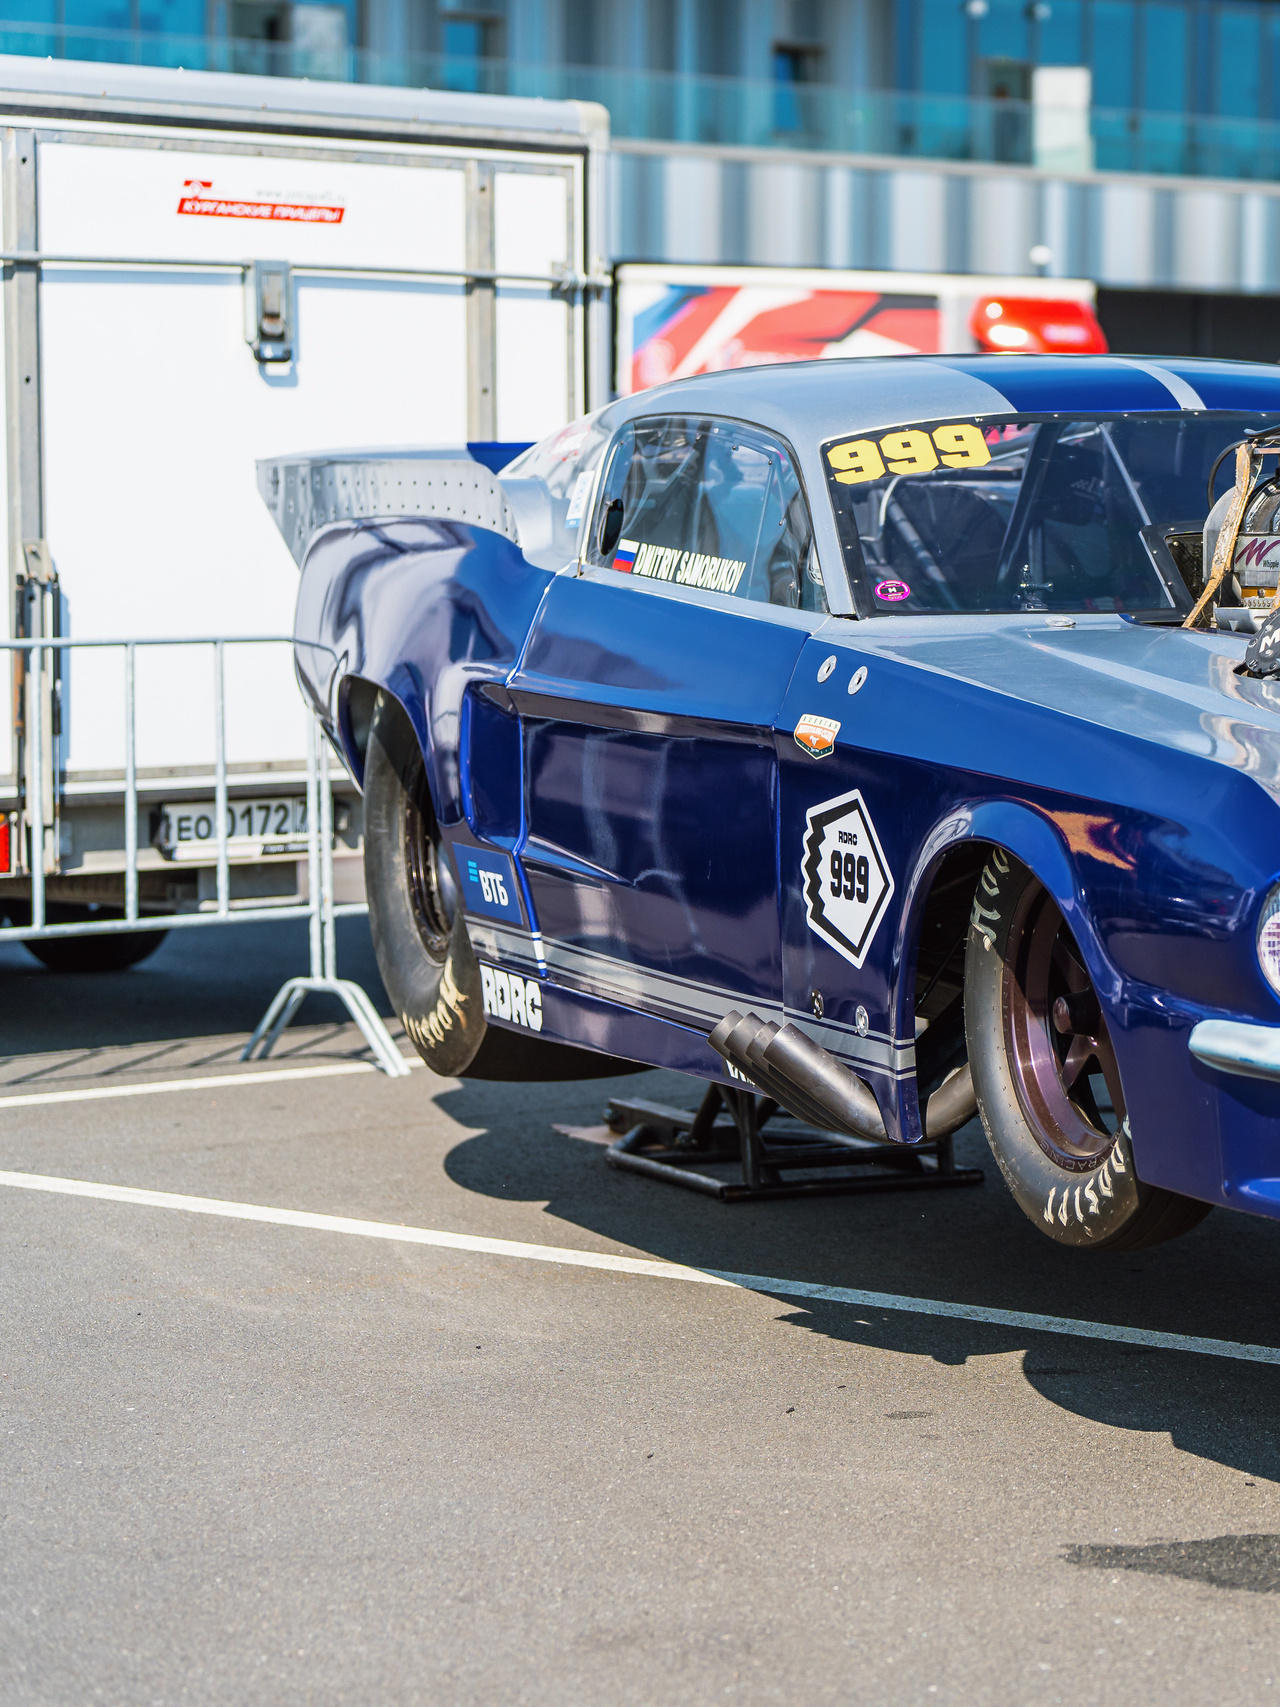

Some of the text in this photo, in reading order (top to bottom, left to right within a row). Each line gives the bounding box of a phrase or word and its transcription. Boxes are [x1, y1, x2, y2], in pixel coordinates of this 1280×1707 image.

[826, 424, 992, 485] 999
[633, 543, 747, 594] DMITRIY SAMORUKOV
[1262, 559, 1280, 570] Whipple
[838, 830, 858, 846] RDRC
[478, 869, 509, 907] ВТБ
[830, 850, 870, 904] 999
[479, 964, 543, 1032] RDRC
